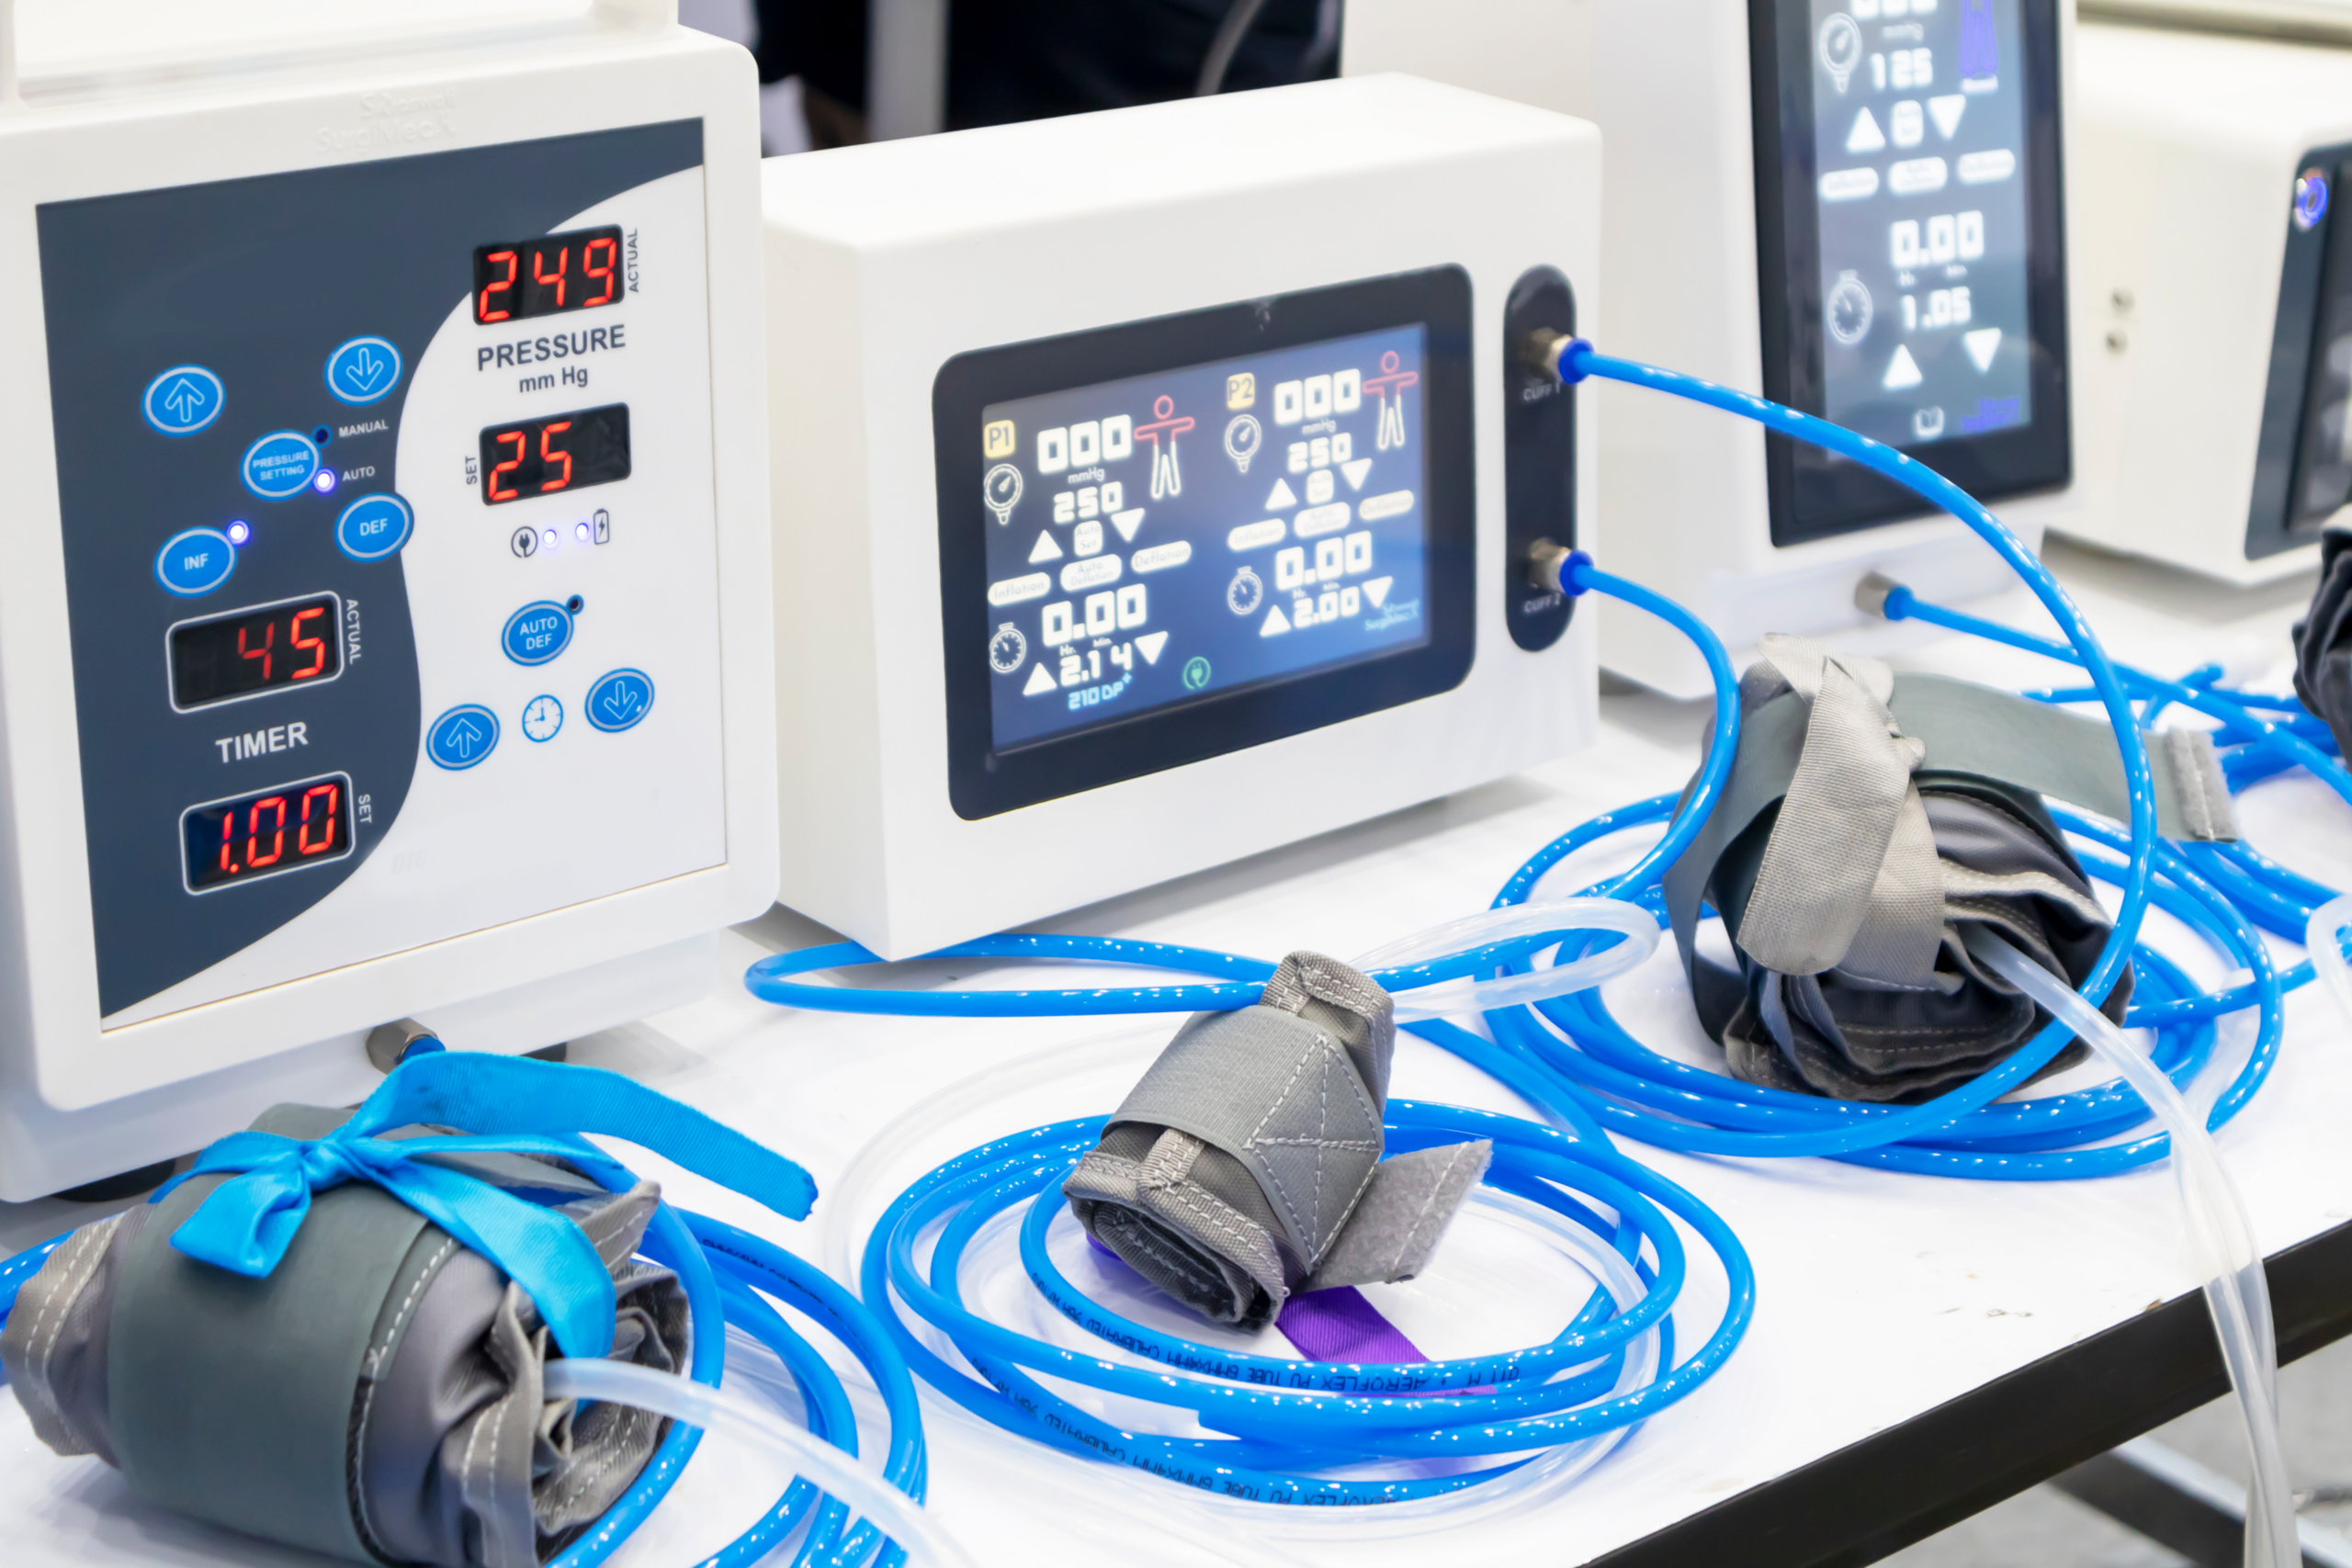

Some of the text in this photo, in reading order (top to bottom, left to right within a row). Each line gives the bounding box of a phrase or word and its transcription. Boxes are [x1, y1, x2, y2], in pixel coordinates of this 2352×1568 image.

[1871, 48, 1933, 90] 125
[1890, 210, 1984, 266] 0.00
[628, 228, 639, 293] ACTUAL
[480, 237, 616, 321] 249
[1901, 286, 1972, 330] 1.05
[478, 324, 626, 371] PRESSURE
[520, 366, 588, 393] mm Hg
[1227, 378, 1254, 402] P2
[1275, 368, 1361, 425] 000
[339, 420, 389, 437] MANUAL
[989, 425, 1010, 450] P1
[1302, 419, 1336, 435] mmHg
[1036, 414, 1132, 474] 000
[1288, 433, 1351, 473] 250
[253, 450, 310, 468] PRESSURE
[465, 456, 478, 485] SET
[489, 422, 572, 501] 25
[260, 465, 305, 480] SETTING
[342, 466, 376, 481] AUTO
[1068, 466, 1104, 485] mmHg
[1053, 480, 1123, 524] 250
[359, 518, 388, 536] DEF
[1076, 525, 1101, 536] Auto
[1080, 538, 1097, 550] Set
[1134, 547, 1191, 567] Deflation
[184, 553, 209, 570] INF
[1276, 530, 1372, 591] 0.00
[994, 581, 1045, 600] Inflation
[1070, 570, 1114, 587] Deflation
[1042, 583, 1147, 647] 0.00
[1294, 586, 1360, 628] 2.00
[346, 599, 361, 664] ACTUAL
[520, 616, 558, 636] AUTO
[238, 607, 324, 680] 45
[526, 633, 552, 650] DEF
[1068, 687, 1100, 711] 210
[215, 722, 309, 763] TIMER
[358, 794, 372, 823] SET
[220, 784, 337, 873] 1.00
[1086, 1319, 1160, 1360] CALIBRATED
[1248, 1367, 1281, 1387] TUBE
[1290, 1372, 1312, 1389] PU
[1321, 1376, 1430, 1393] AEROFLEX
[1465, 1370, 1483, 1382] M
[1044, 1413, 1126, 1462] CALIBRATED
[1133, 1454, 1214, 1495] 6MMX4MM
[1224, 1480, 1260, 1502] TUBE
[1270, 1490, 1296, 1506] PU
